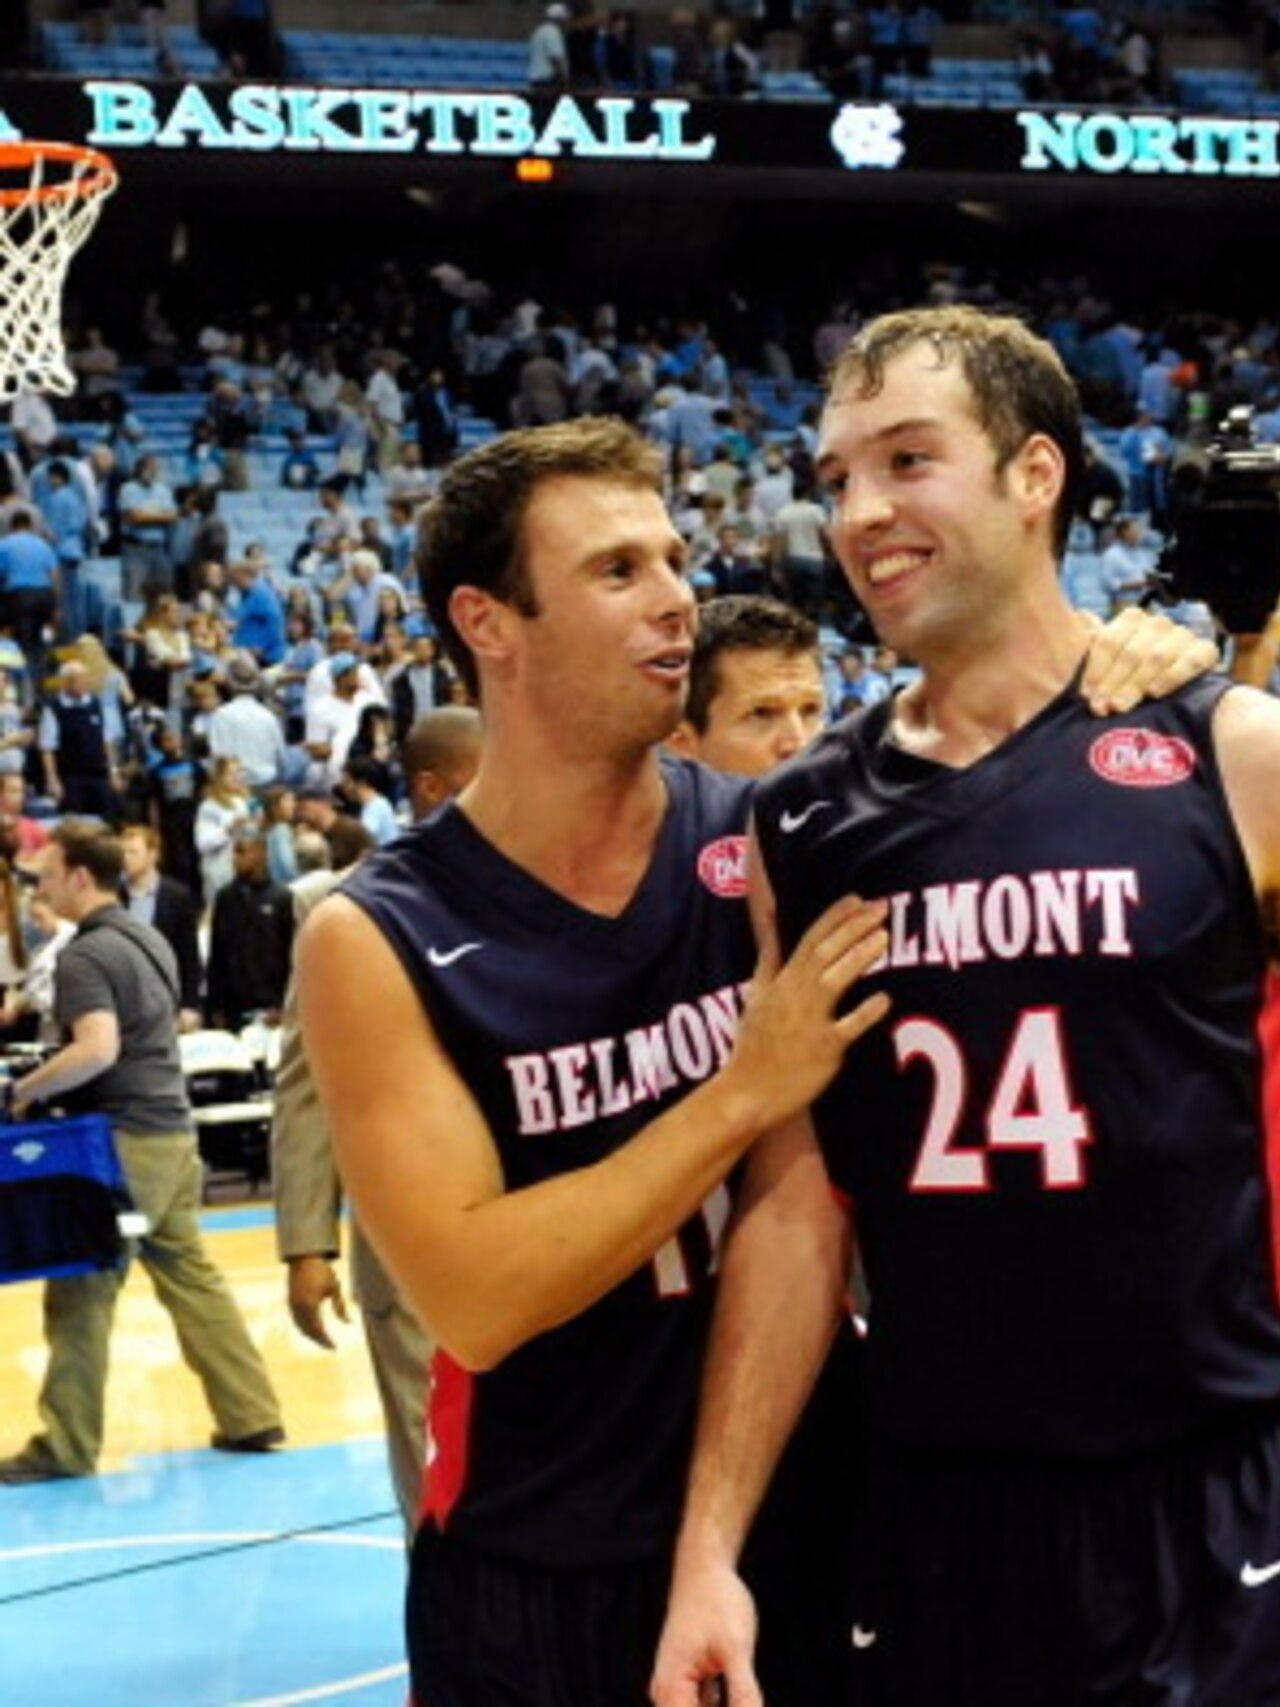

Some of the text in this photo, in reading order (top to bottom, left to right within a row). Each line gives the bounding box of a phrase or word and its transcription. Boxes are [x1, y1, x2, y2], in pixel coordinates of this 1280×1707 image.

[82, 81, 716, 160] BASKETBALL
[504, 977, 758, 1136] BELMON
[892, 1007, 1092, 1190] 24
